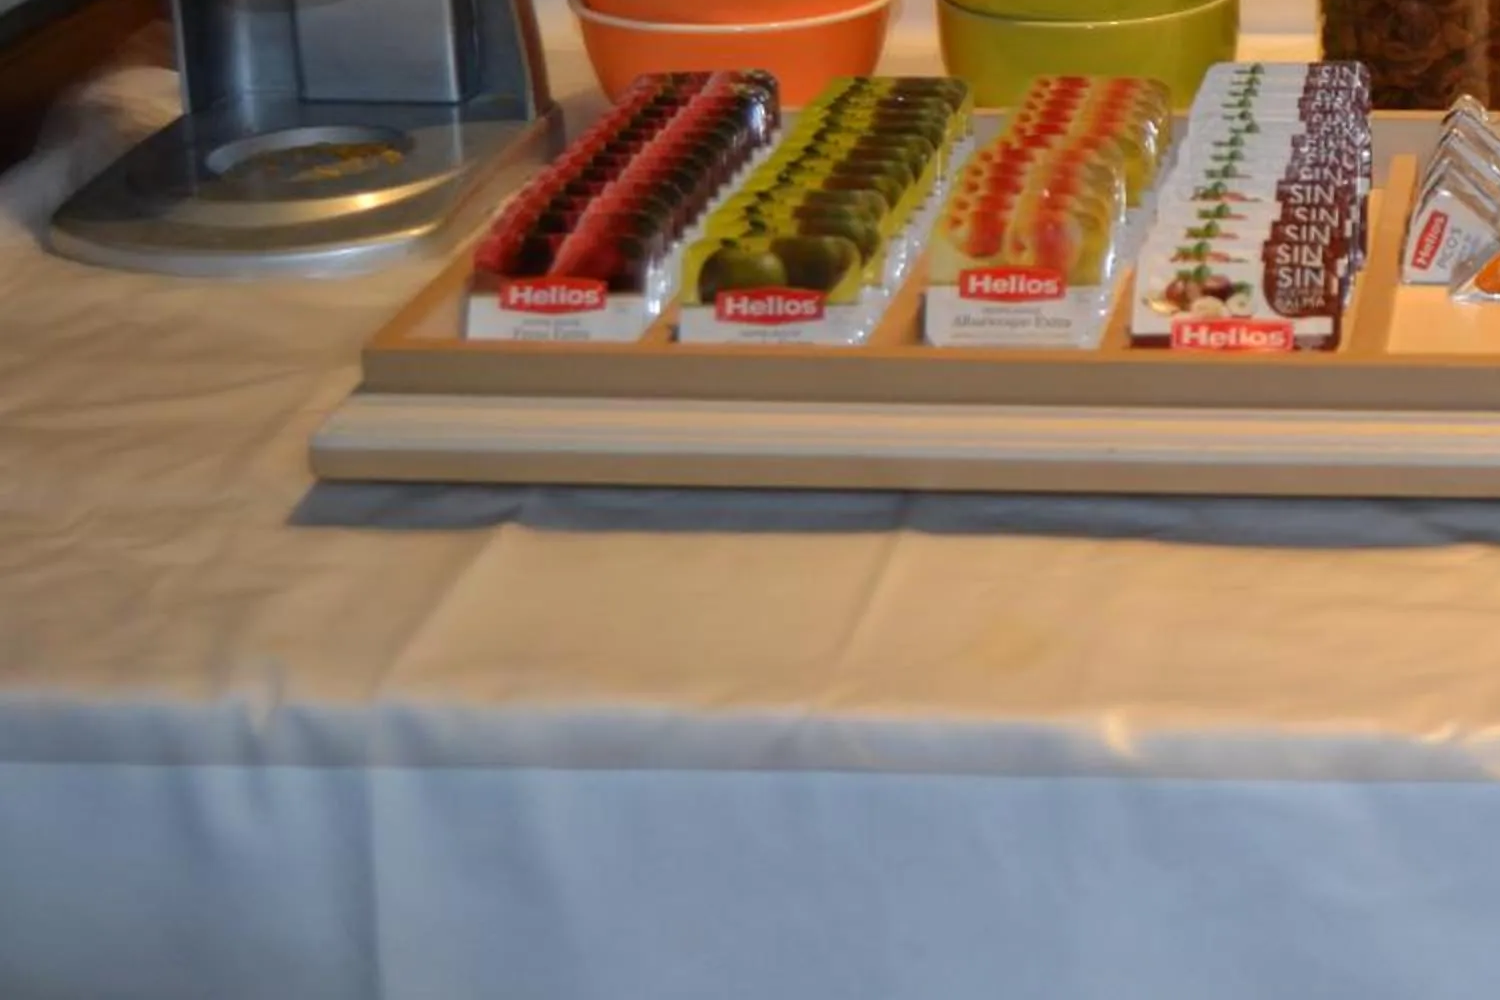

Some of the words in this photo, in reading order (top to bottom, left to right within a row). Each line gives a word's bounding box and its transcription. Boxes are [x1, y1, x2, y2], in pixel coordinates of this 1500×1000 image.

[1290, 184, 1335, 205] SIN
[1294, 206, 1340, 228] SIN
[1285, 225, 1331, 246] SIN
[1416, 216, 1446, 268] Helios
[1275, 244, 1323, 266] SIN
[968, 274, 1058, 295] Helios
[1276, 266, 1325, 288] SIN
[508, 284, 600, 306] Helios
[725, 295, 818, 316] Helios
[1181, 324, 1286, 347] Helios
